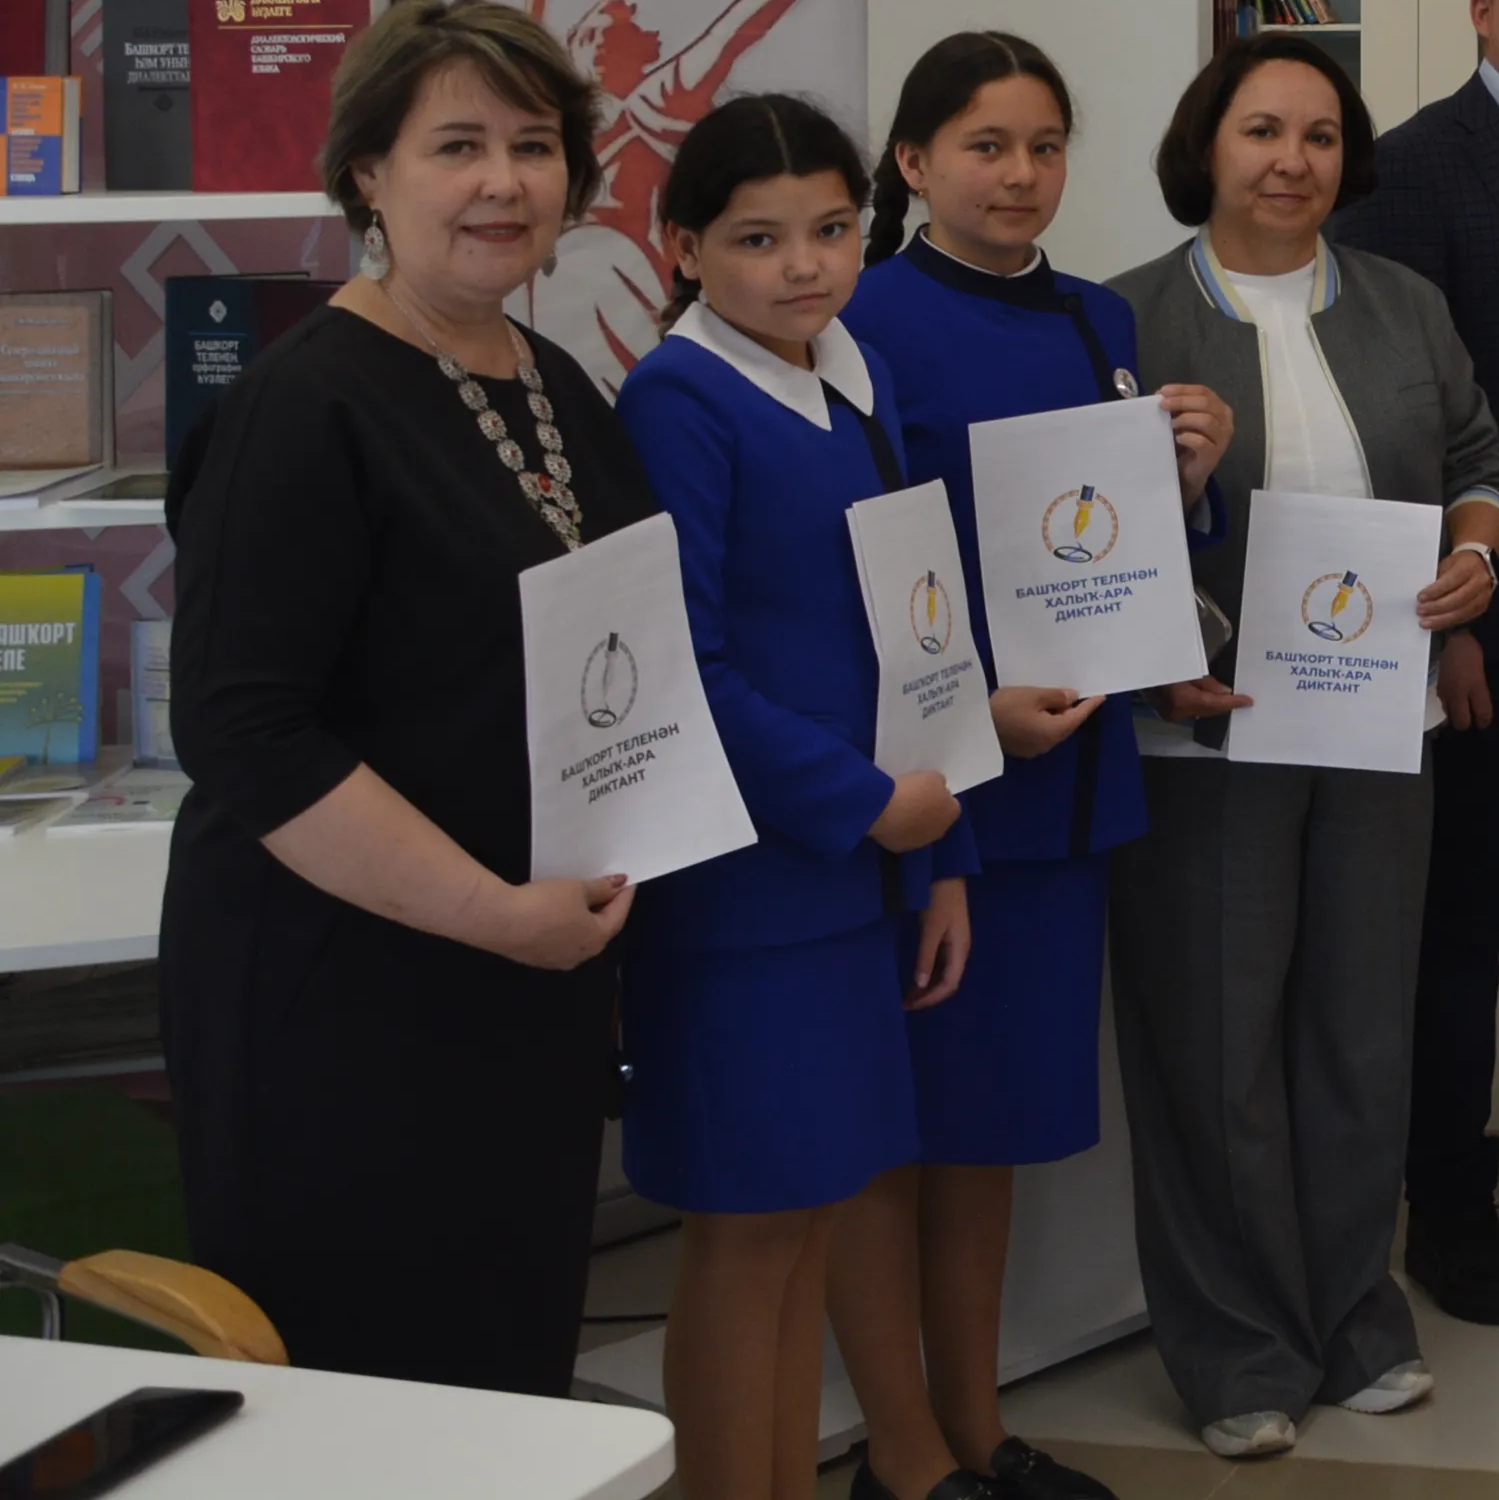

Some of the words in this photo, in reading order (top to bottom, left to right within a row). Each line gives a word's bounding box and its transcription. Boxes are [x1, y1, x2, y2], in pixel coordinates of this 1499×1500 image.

[1015, 578, 1088, 600] БАШҠОРТ
[1091, 567, 1158, 588] ТЕЛЕНӘН
[1044, 586, 1133, 609] ХАЛЫҠ-АРА
[1055, 602, 1122, 624] ДИКТАНТ
[1265, 650, 1334, 665] БАШҠОРТ
[1337, 656, 1399, 671] ТЕЛЕНӘН
[1290, 666, 1372, 682] ХАЛЫҠ-АРА
[1296, 679, 1361, 694] ДИКТАНТ
[616, 723, 680, 756] ТЕЛЕНӘН
[588, 769, 646, 804] ДИКТАНТ
